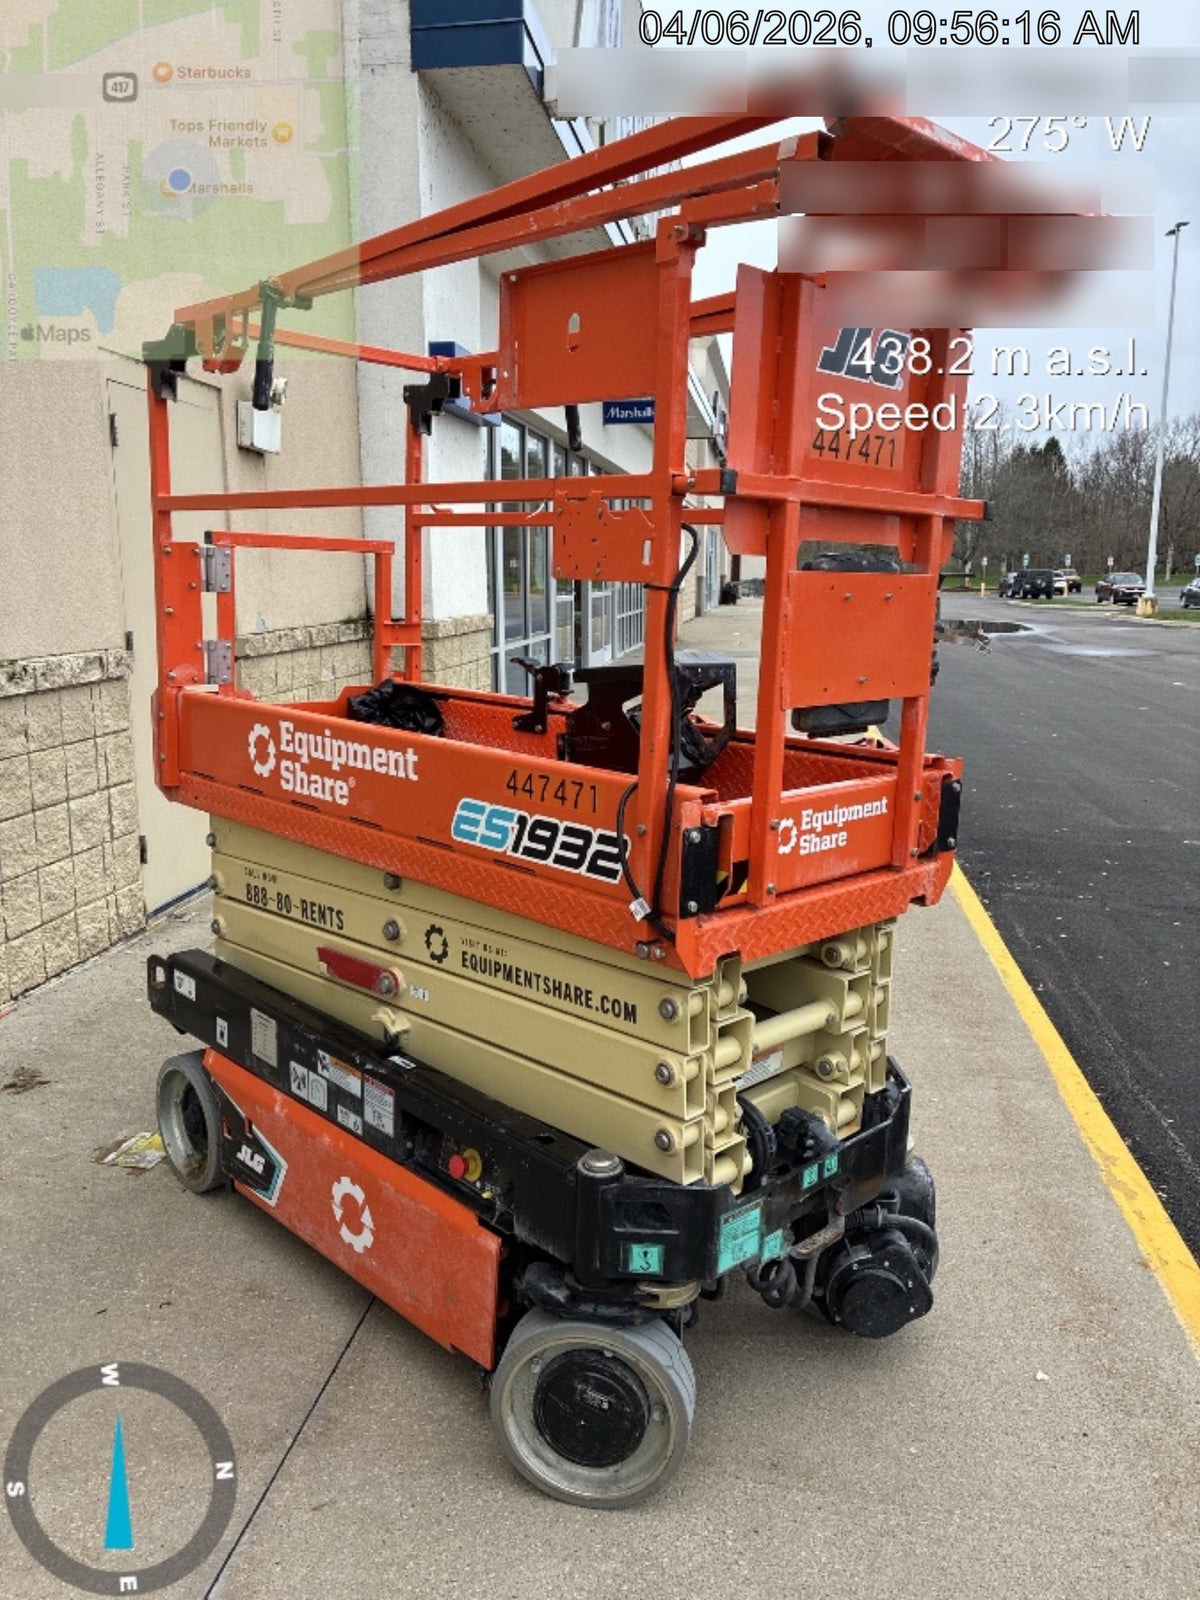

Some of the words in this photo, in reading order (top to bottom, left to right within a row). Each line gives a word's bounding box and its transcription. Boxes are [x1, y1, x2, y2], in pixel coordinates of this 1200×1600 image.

[279, 719, 419, 782] Equipment
[506, 768, 597, 814] 447471
[801, 795, 889, 832] Equipment
[452, 798, 631, 883] ES1932
[799, 830, 848, 856] Share
[245, 882, 345, 931] 888-80-RENTS
[460, 950, 638, 1025] EQUIPMENTSHARE.COM
[236, 1144, 266, 1175] JLG
